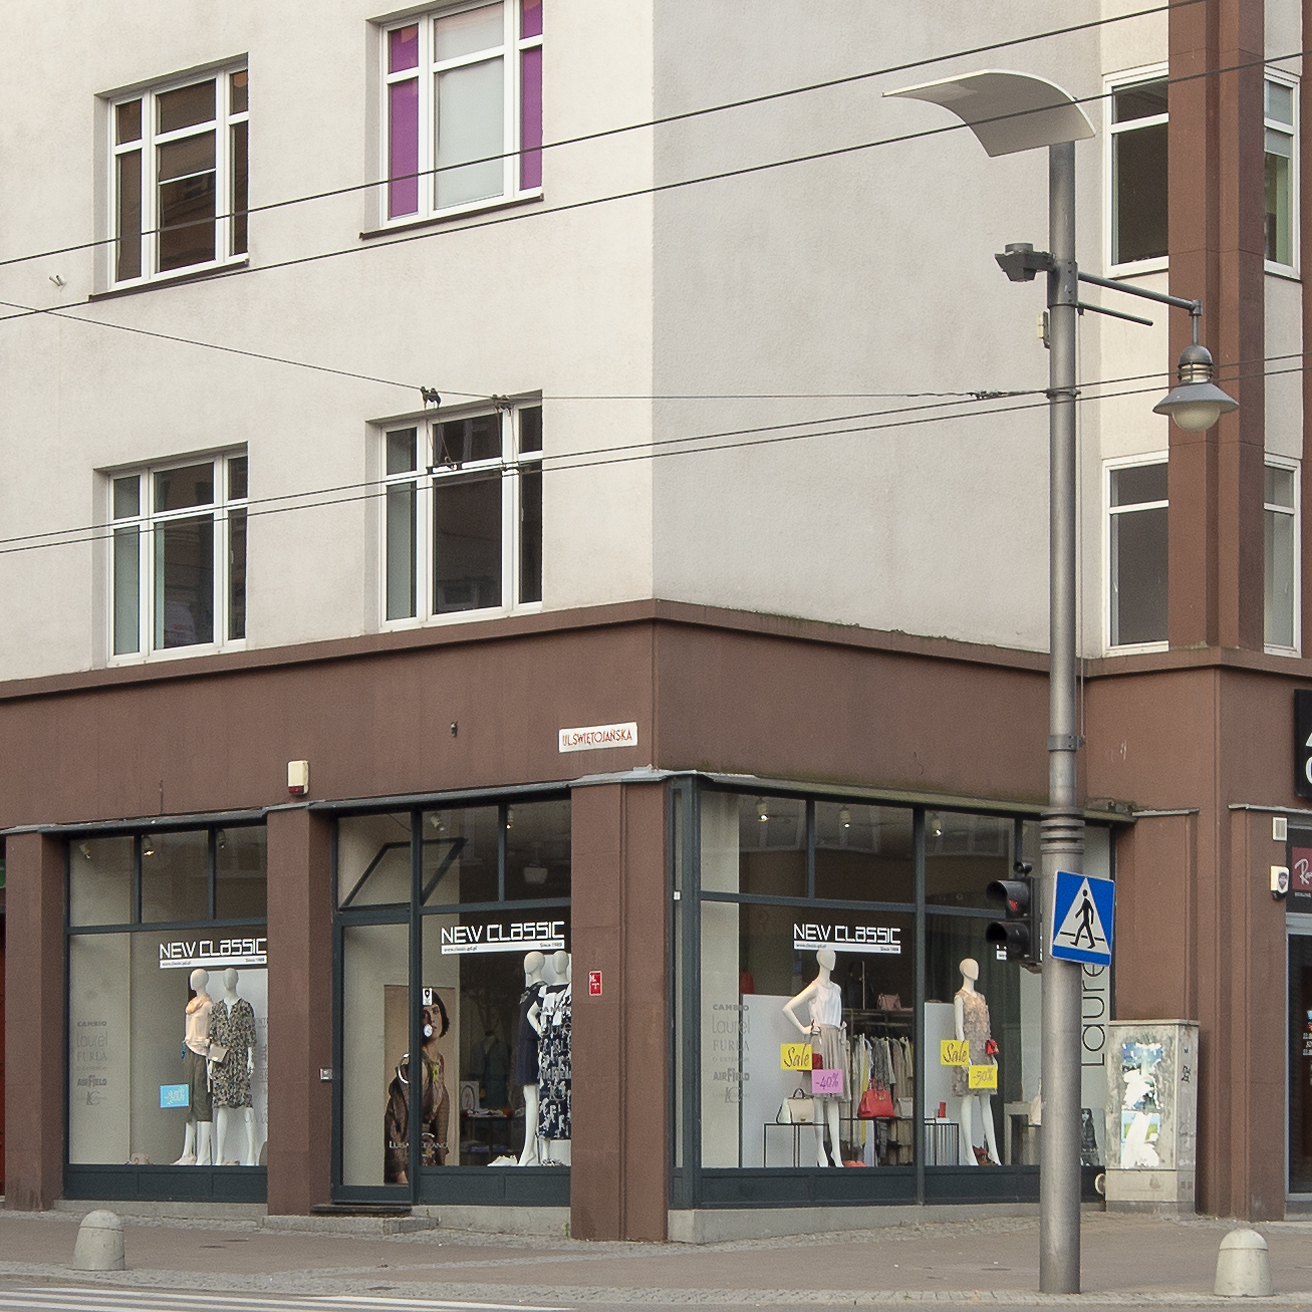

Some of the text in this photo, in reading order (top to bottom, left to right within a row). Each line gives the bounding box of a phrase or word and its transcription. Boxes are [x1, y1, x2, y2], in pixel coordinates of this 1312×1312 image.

[440, 924, 484, 945] NEW
[793, 923, 832, 941] NEW
[159, 941, 197, 960] NEW
[783, 1043, 810, 1068] Sale
[943, 1040, 968, 1063] Sale
